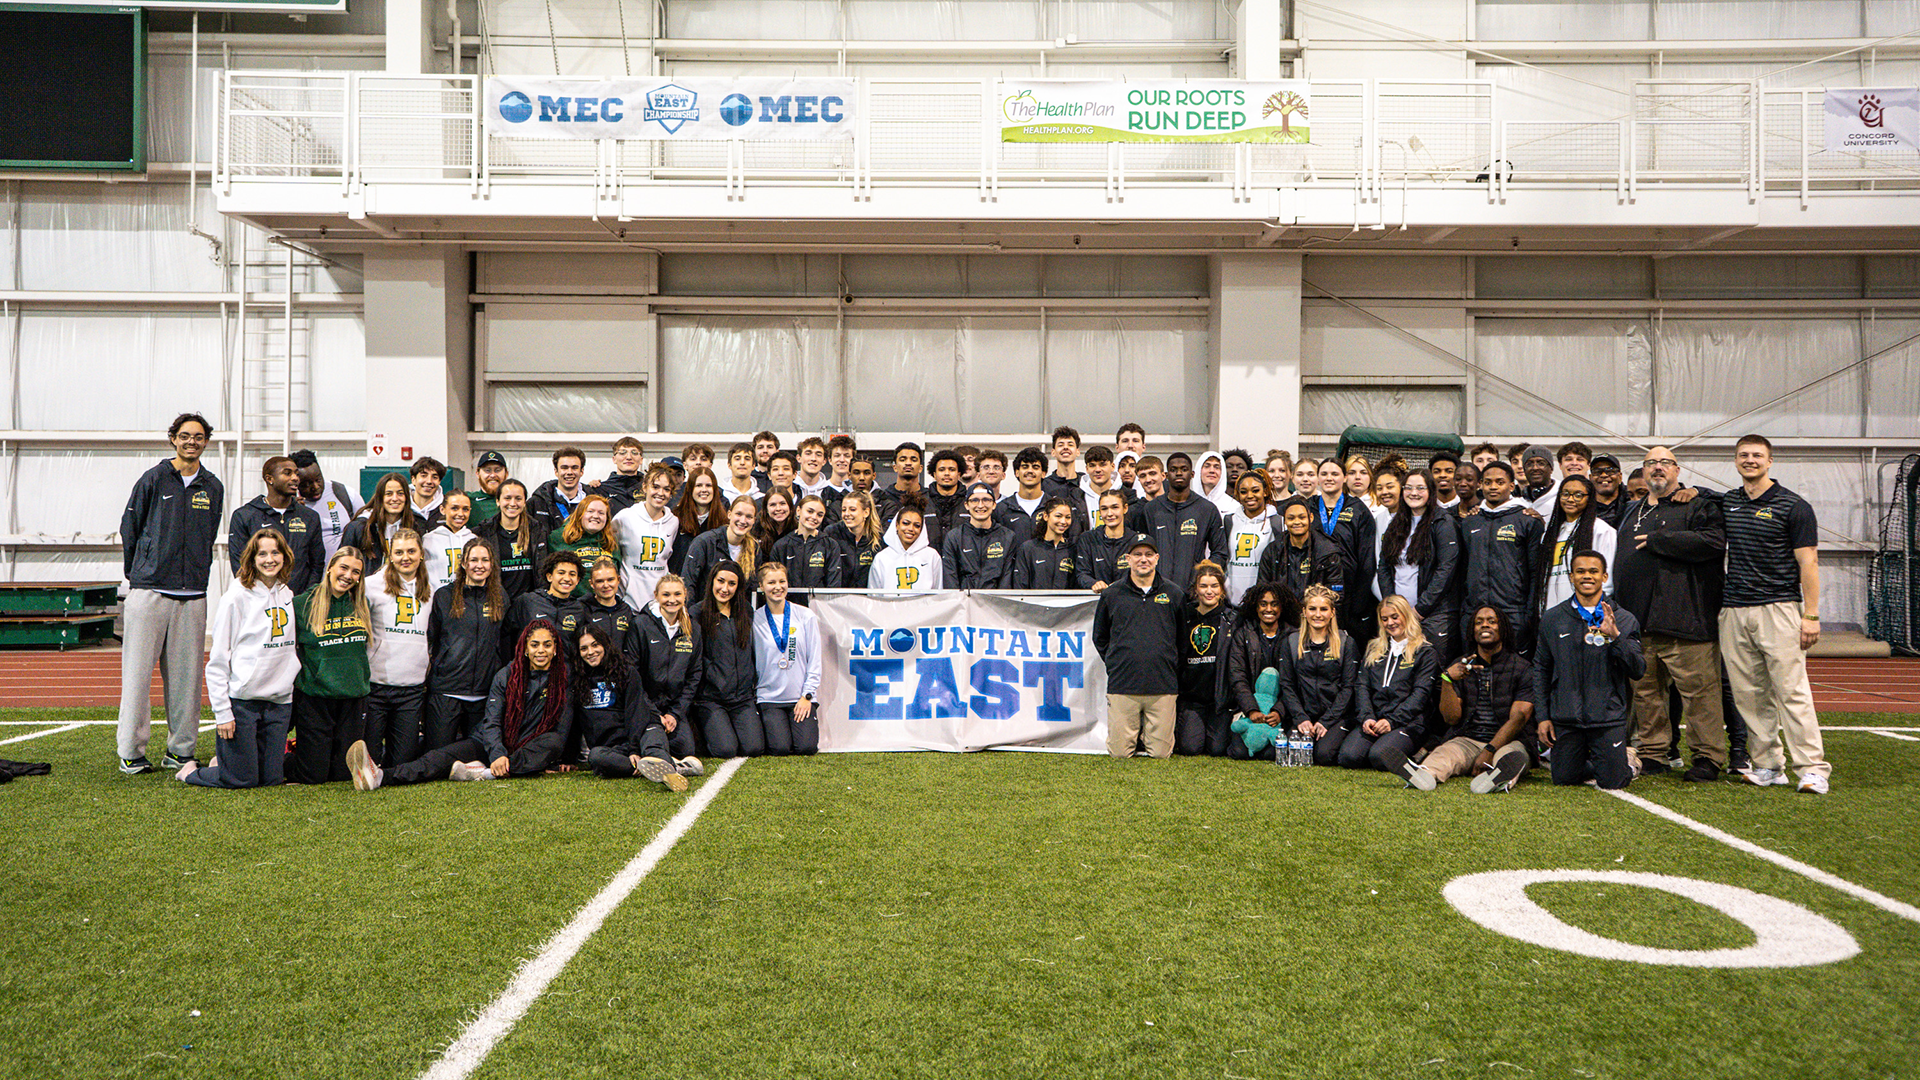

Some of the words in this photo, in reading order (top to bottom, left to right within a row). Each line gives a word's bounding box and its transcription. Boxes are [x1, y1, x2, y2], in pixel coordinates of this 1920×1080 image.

[654, 98, 689, 108] EAST
[1127, 89, 1171, 106] OUR
[1176, 89, 1246, 106] ROOTS
[537, 95, 624, 123] MEC
[645, 109, 699, 120] CHAMPIONSHIP
[758, 96, 844, 123] MEC
[1023, 126, 1095, 136] HEALTHPLAN.ORG
[1128, 111, 1179, 130] RUN
[1186, 111, 1247, 130] DEEP
[327, 500, 337, 511] P
[1137, 534, 1147, 542] P
[1235, 532, 1260, 561] P
[640, 535, 666, 565] P
[895, 566, 920, 588] P
[395, 594, 422, 627] P
[264, 606, 289, 642] P
[318, 638, 343, 648] TRACK
[850, 626, 1087, 659] MOUNTAIN
[848, 656, 1085, 723] EAST
